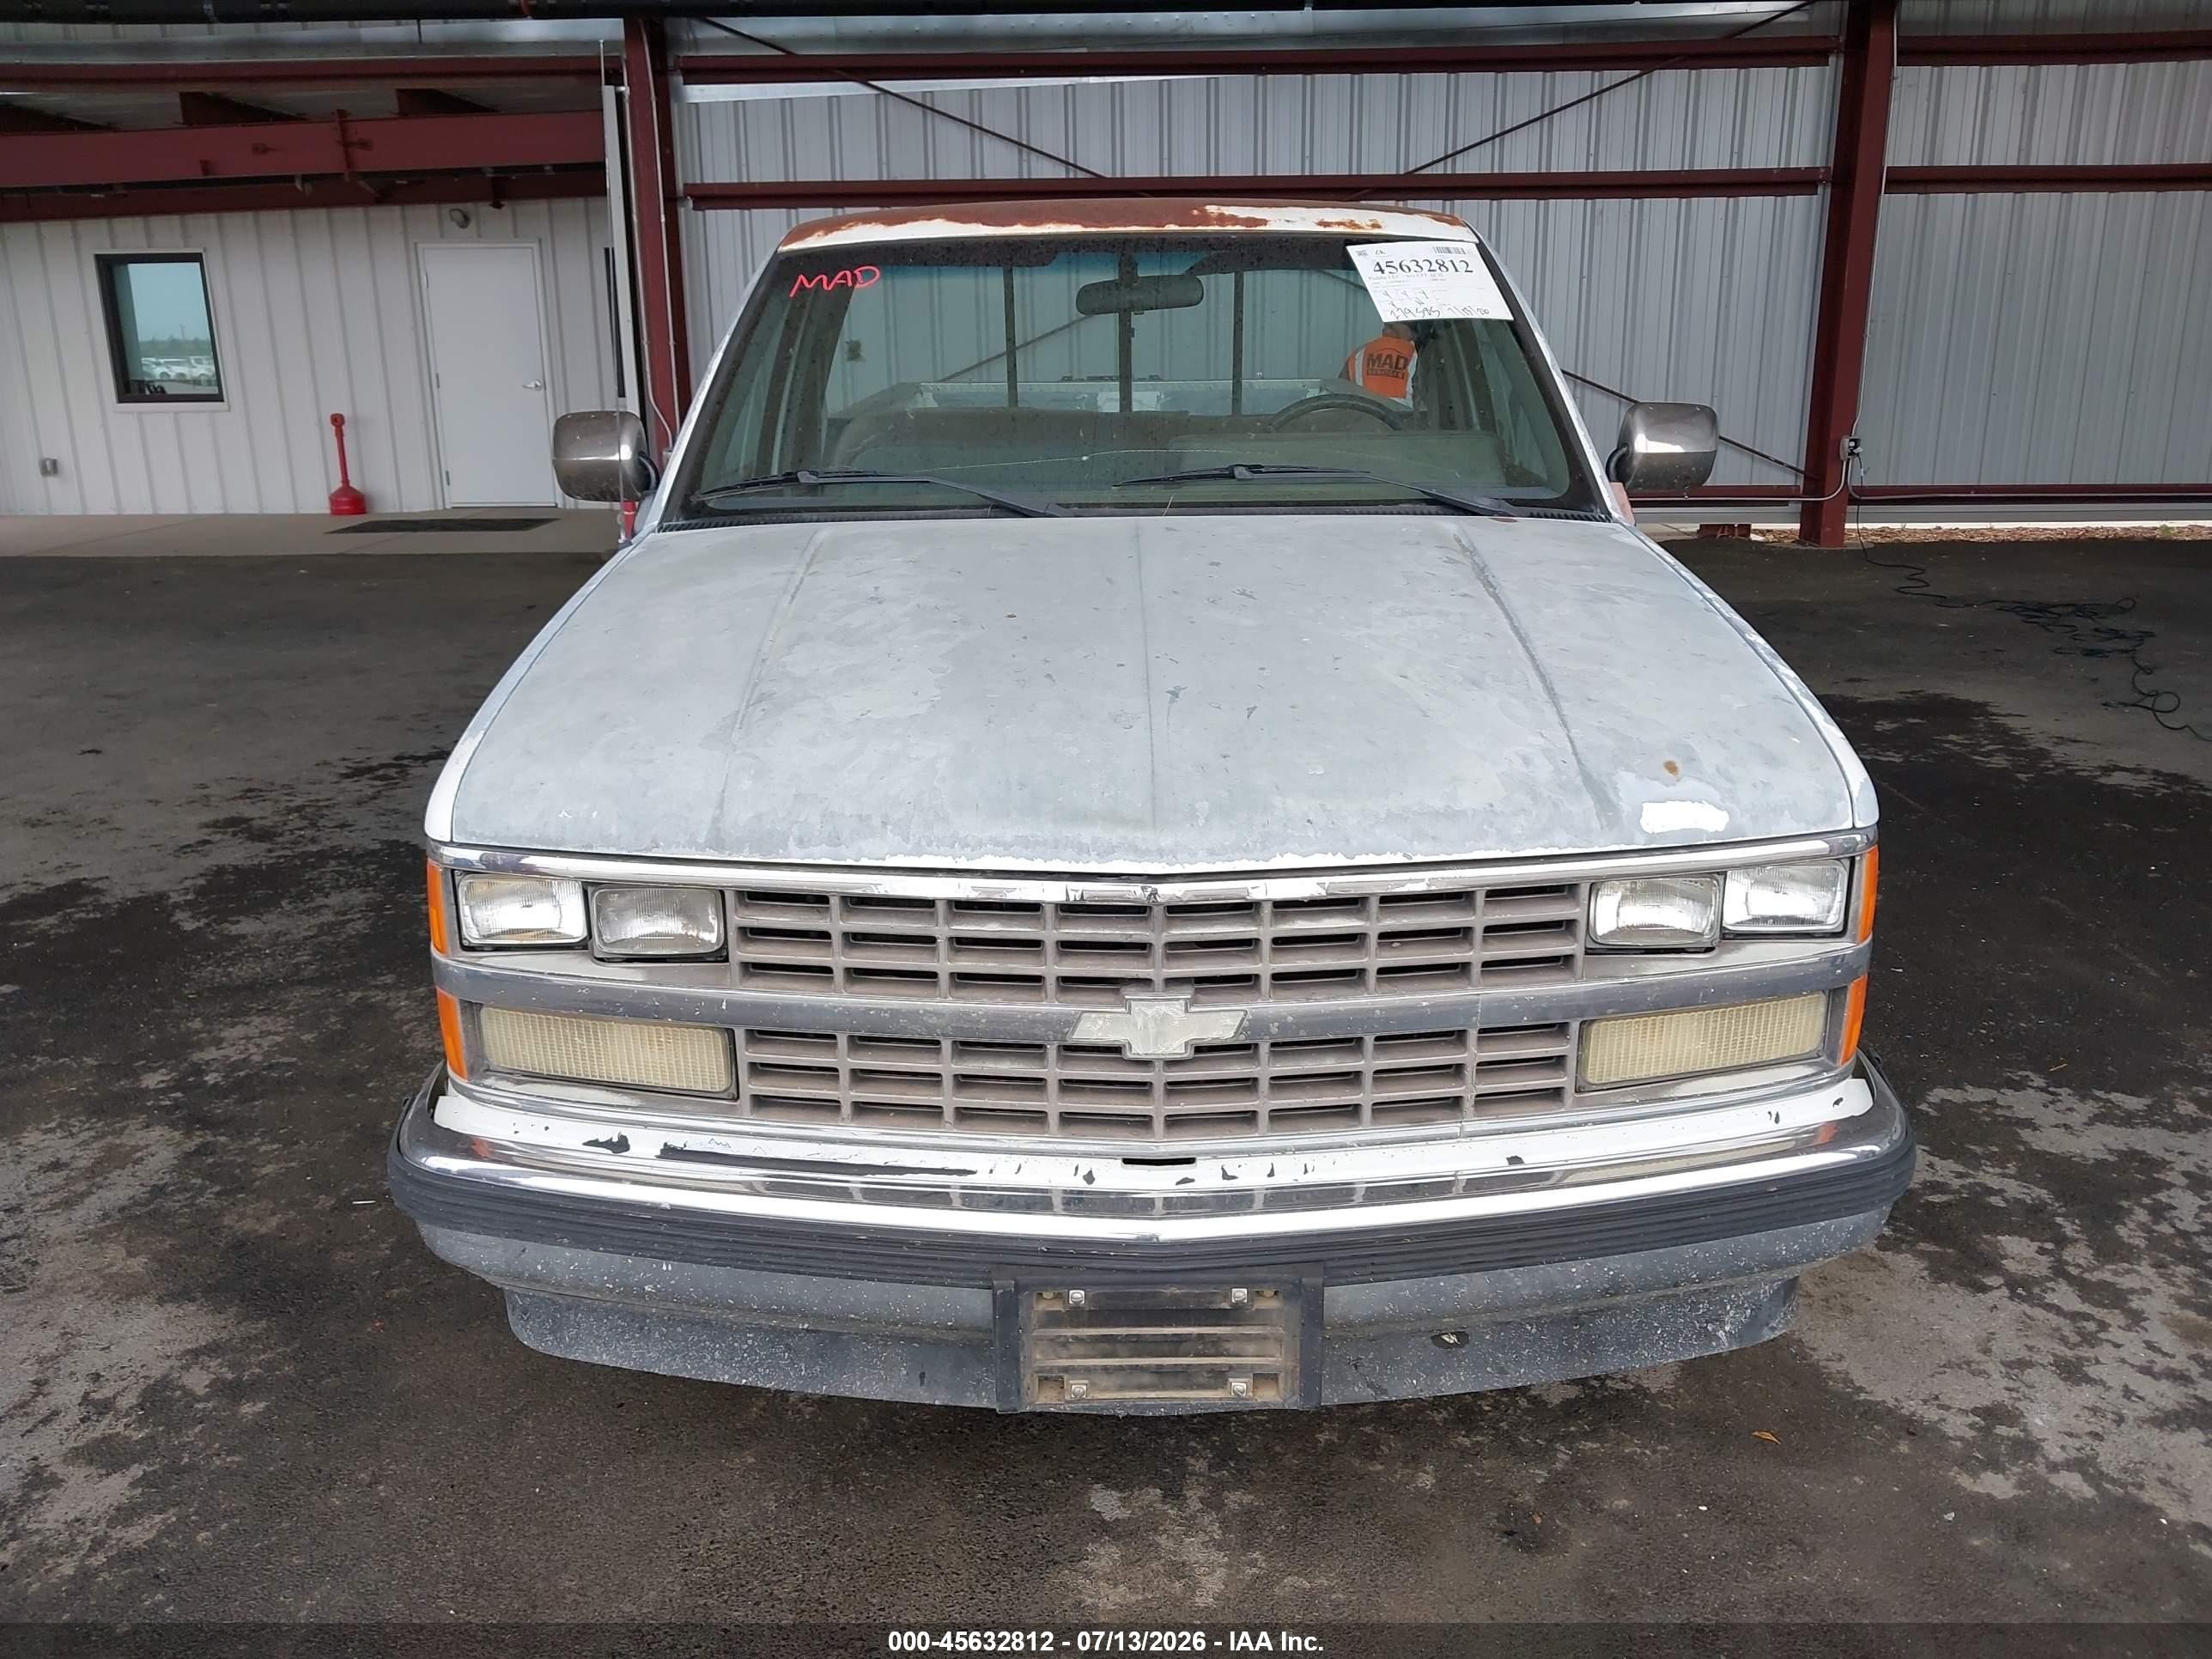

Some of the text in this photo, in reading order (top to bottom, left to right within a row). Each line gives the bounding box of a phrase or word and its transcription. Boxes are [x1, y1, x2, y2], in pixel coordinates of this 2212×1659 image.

[1373, 258, 1474, 275] 45632812
[789, 264, 880, 297] MAD
[1367, 353, 1408, 370] MAD
